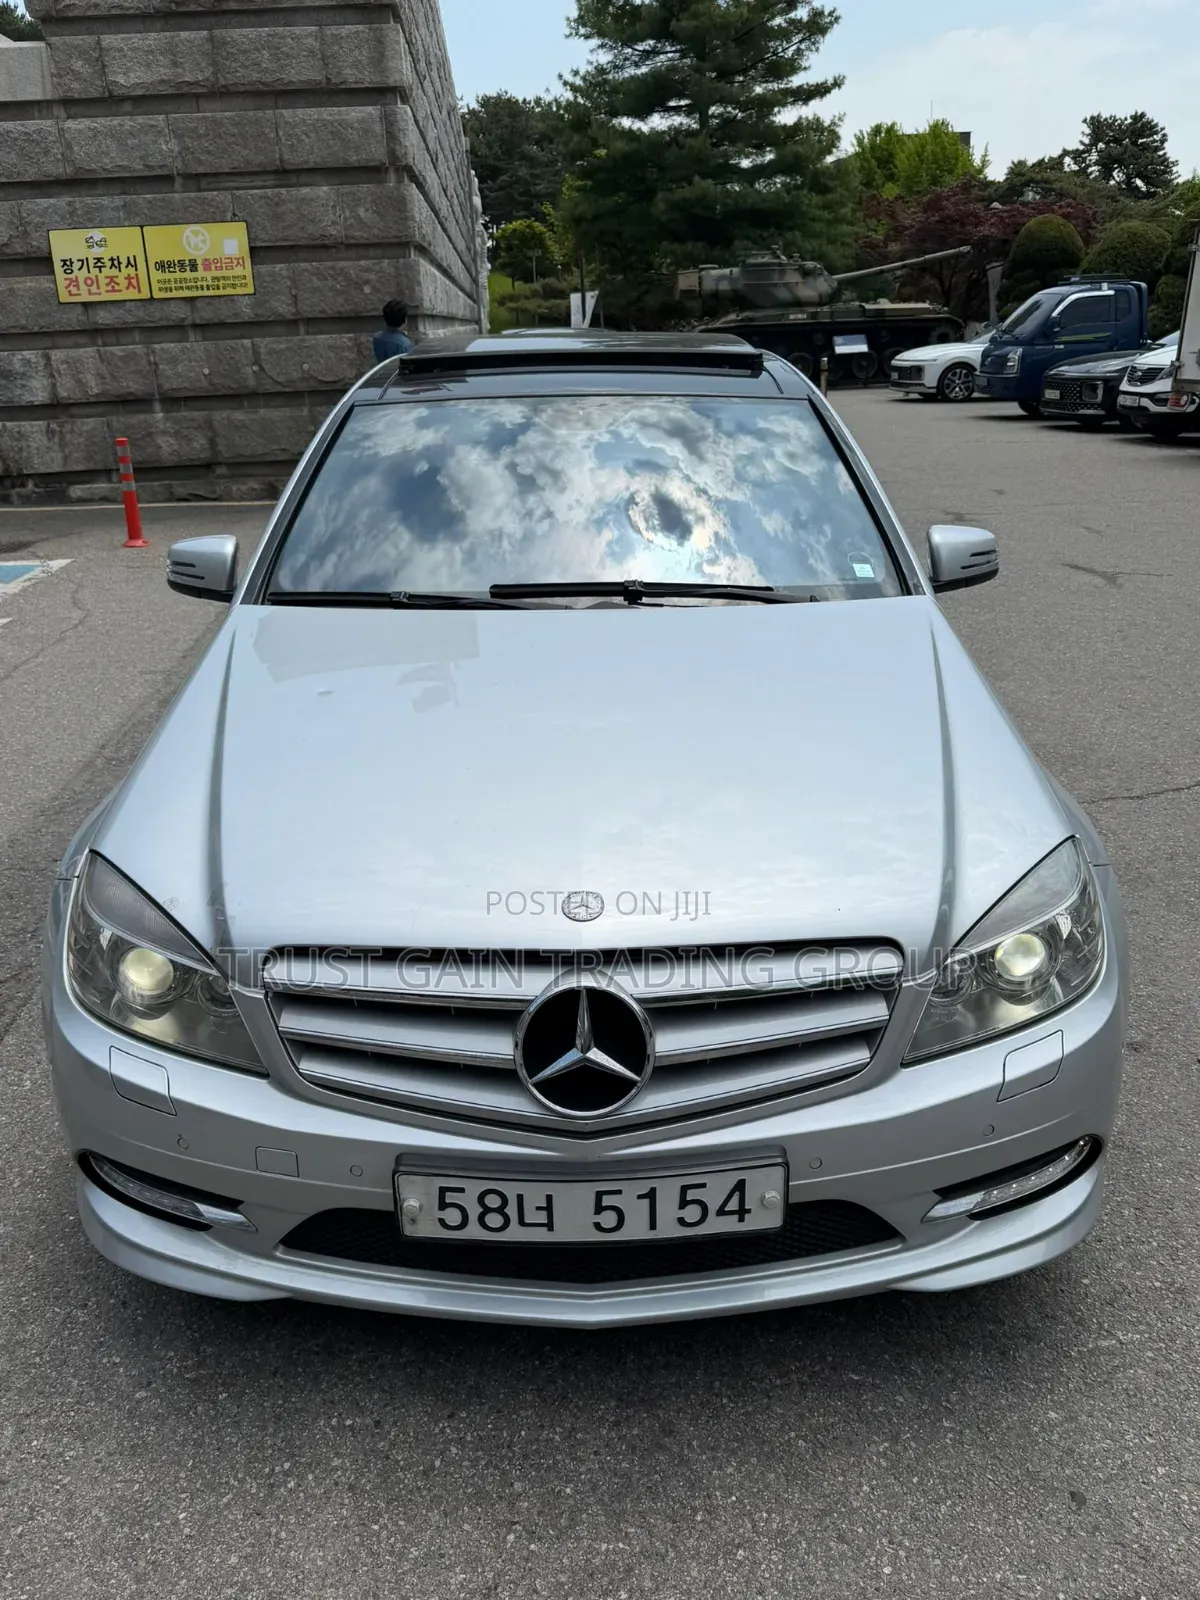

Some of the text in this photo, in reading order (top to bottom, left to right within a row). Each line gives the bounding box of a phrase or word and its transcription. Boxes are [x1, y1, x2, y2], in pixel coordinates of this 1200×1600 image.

[60, 255, 138, 275] 장기주차시
[154, 256, 246, 274] 애완동물 출입금지
[64, 273, 142, 297] 견인조치
[437, 1178, 752, 1233] 58너 5154
